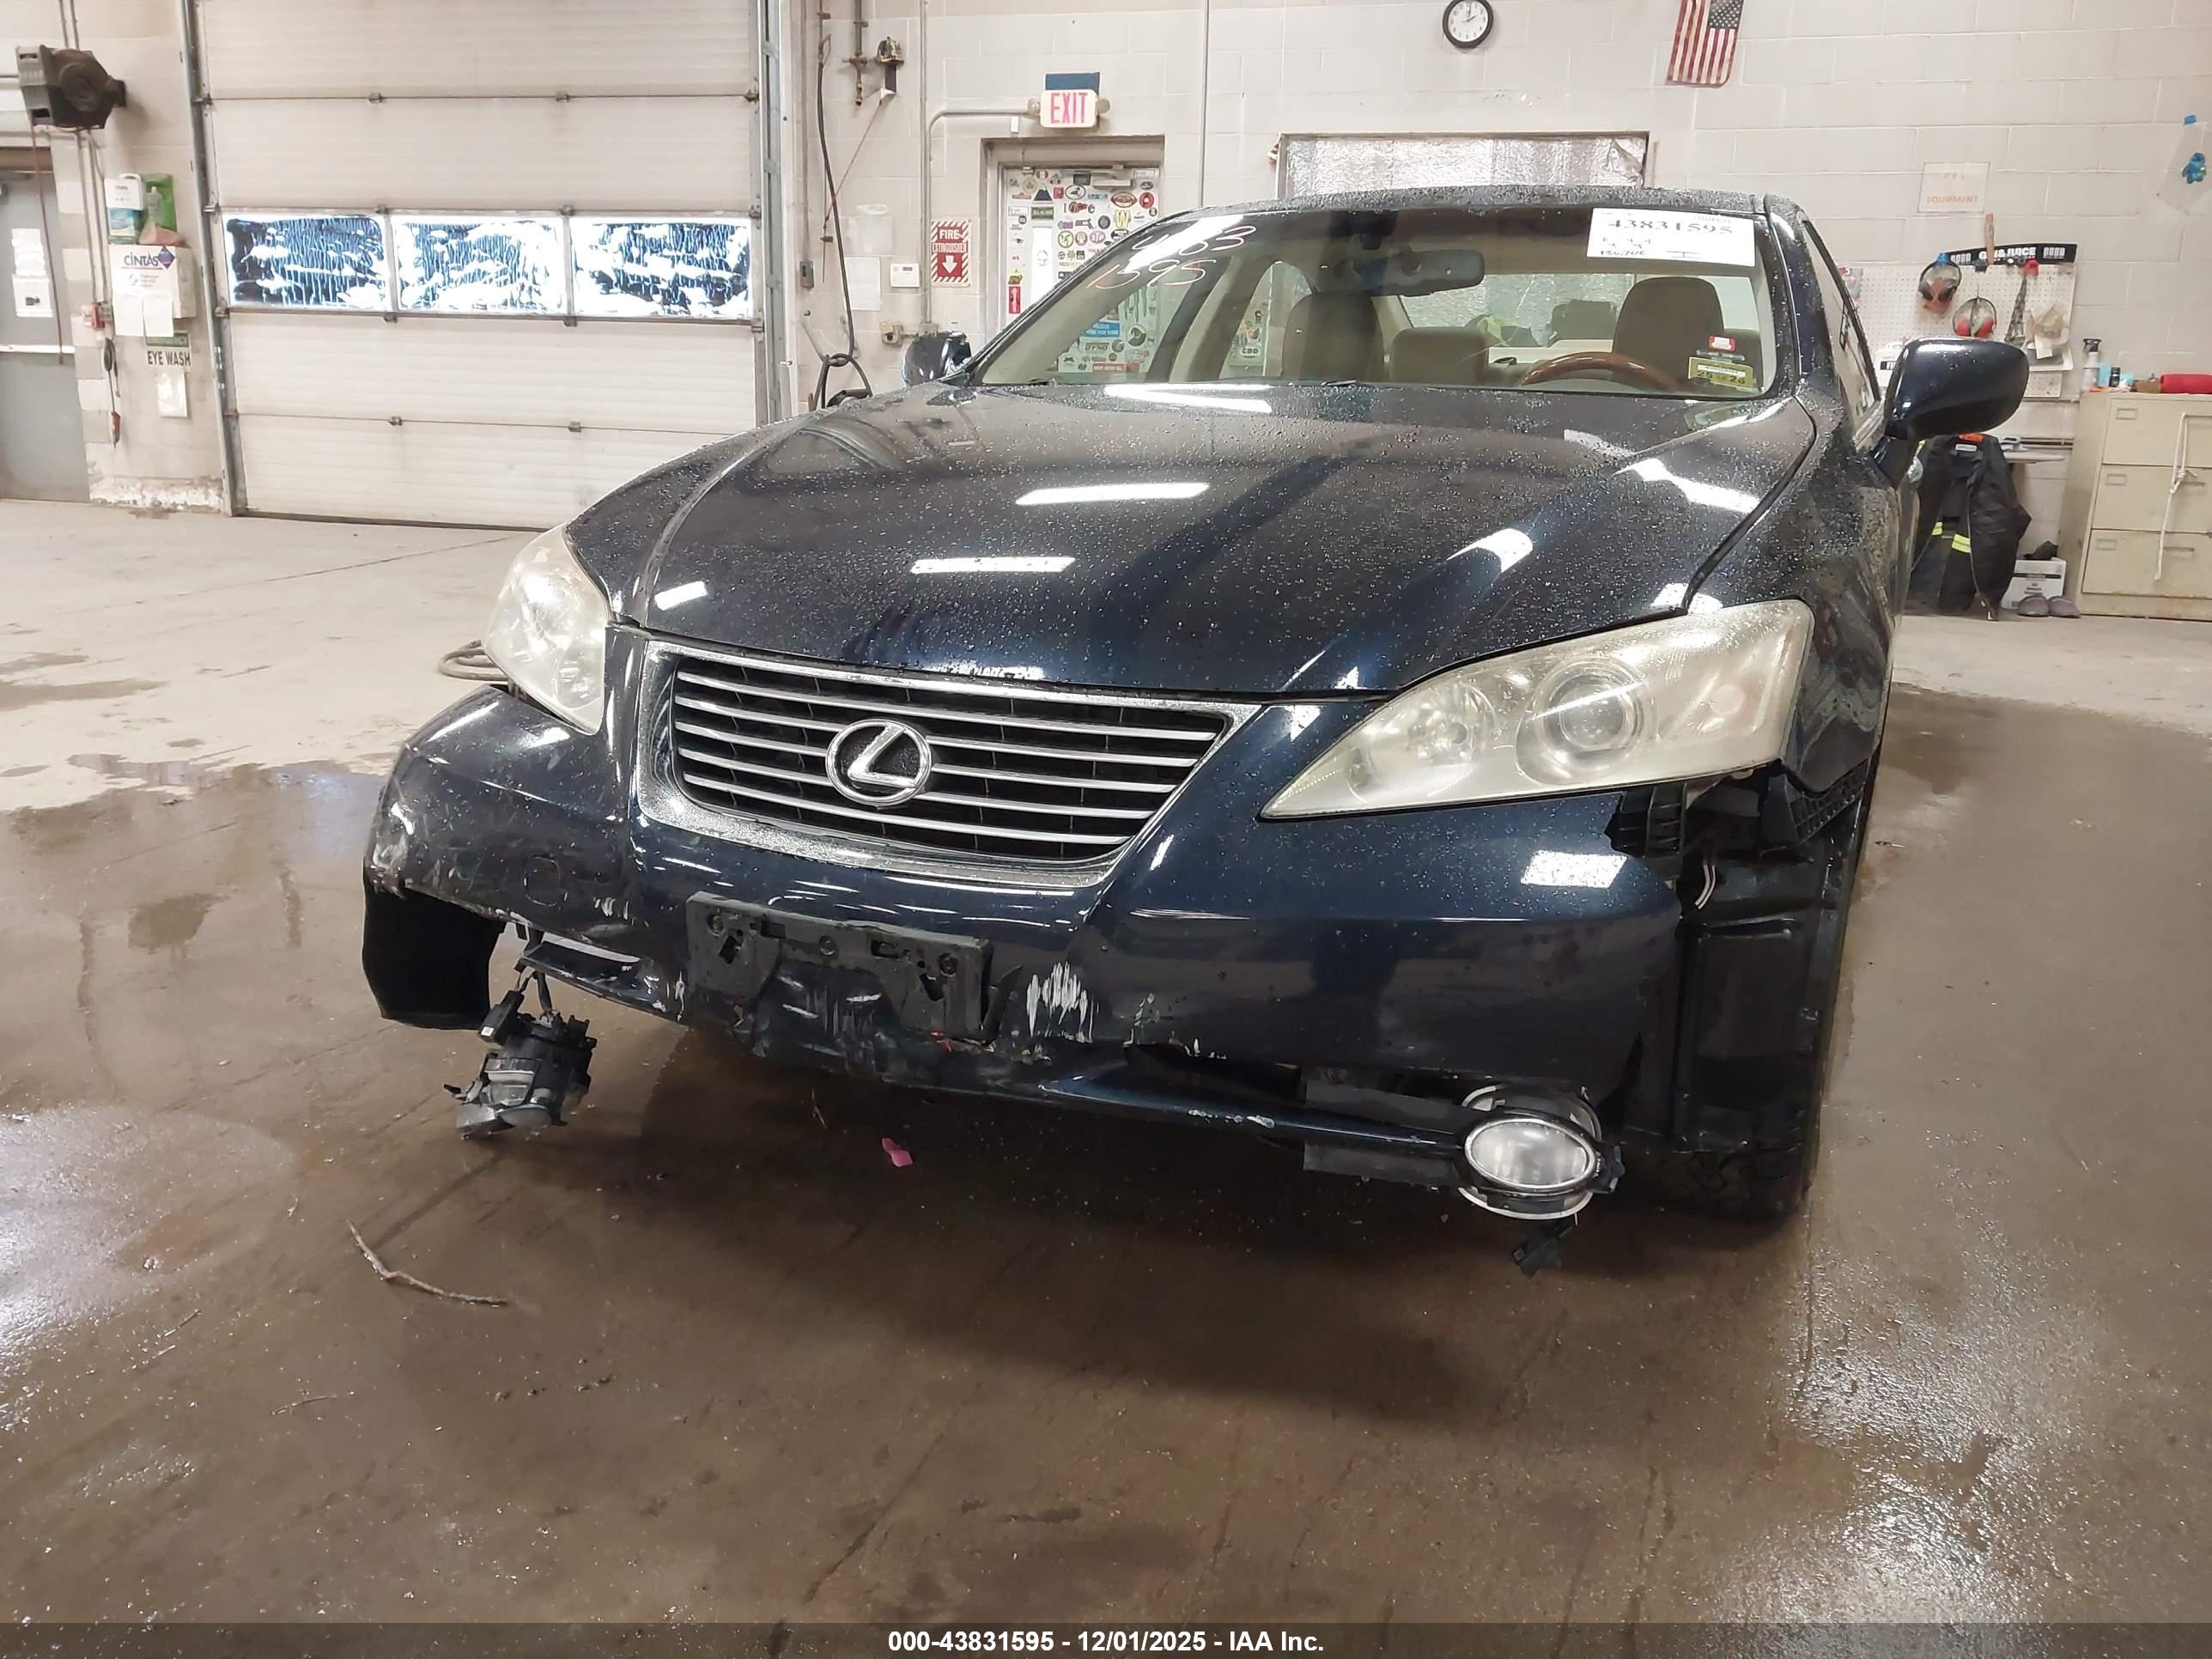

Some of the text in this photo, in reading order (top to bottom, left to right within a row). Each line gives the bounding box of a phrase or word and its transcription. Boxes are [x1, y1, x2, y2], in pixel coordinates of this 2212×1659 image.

[1050, 92, 1088, 124] EXIT
[1607, 219, 1732, 234] 43831595
[939, 228, 961, 240] FIRE
[124, 252, 159, 266] CINTAS
[1978, 246, 2036, 259] GN&JUICE
[147, 350, 191, 367] EYE WASH
